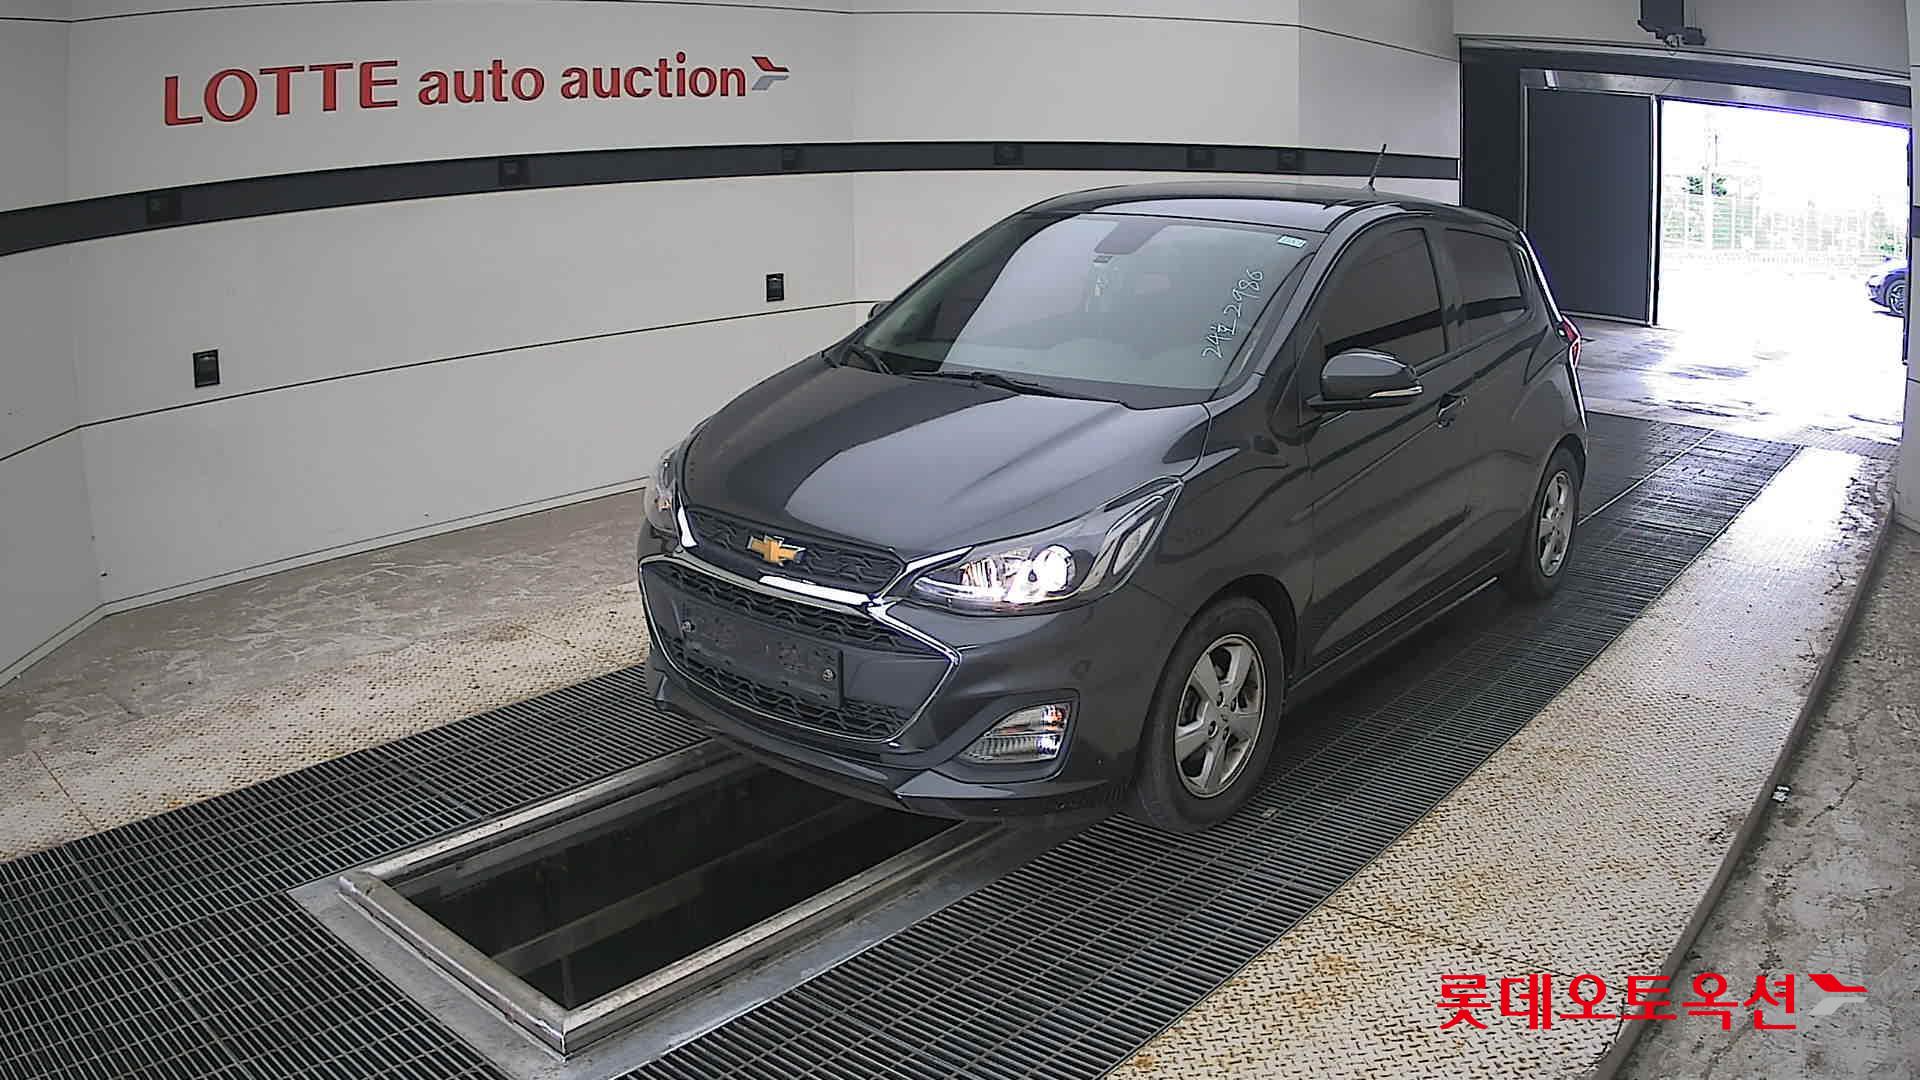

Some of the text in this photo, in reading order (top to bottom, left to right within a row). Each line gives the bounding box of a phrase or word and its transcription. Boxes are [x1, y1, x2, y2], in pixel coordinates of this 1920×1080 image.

[164, 51, 747, 126] LOTTE auto auction
